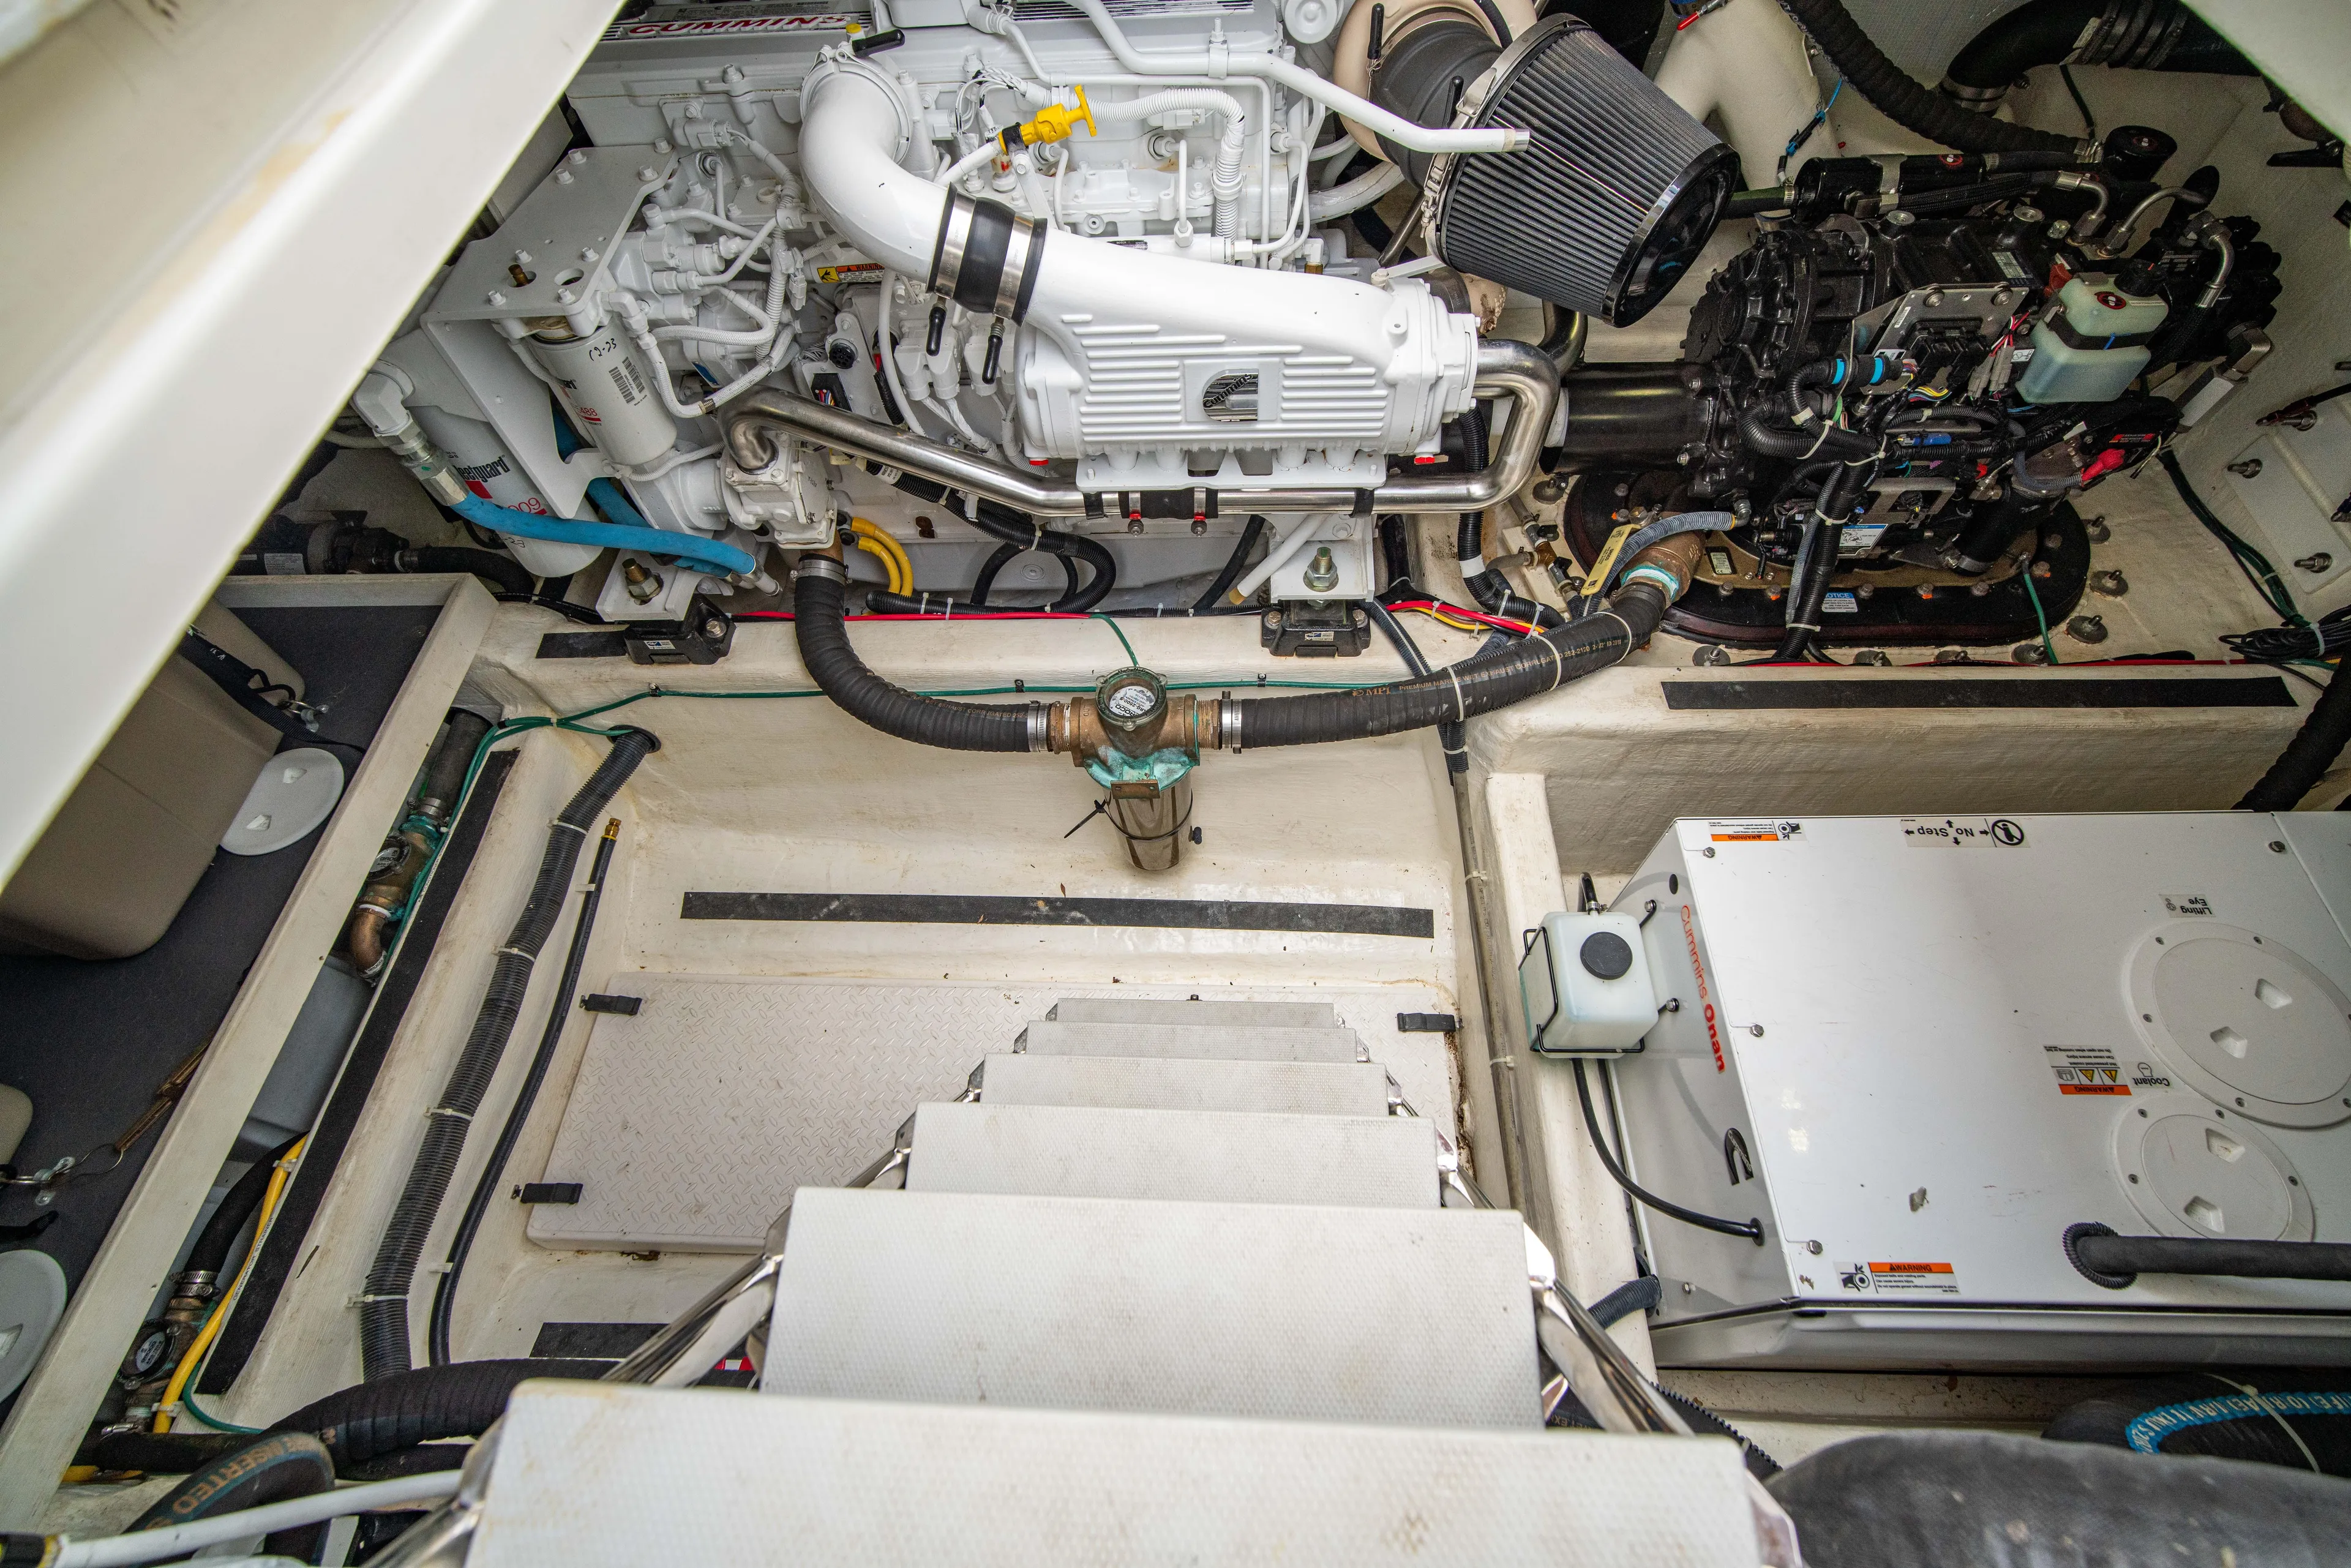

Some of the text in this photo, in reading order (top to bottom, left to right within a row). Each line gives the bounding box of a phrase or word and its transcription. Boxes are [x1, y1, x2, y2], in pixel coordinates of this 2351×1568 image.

[628, 16, 850, 35] CUMMINS
[1202, 373, 1253, 408] Cummins
[1366, 686, 1392, 696] MPI
[1399, 681, 1432, 691] PREMIUM
[1480, 666, 1515, 678] EXHAUST
[1515, 653, 1564, 670] CORRUGATD
[1564, 646, 1591, 658] 252-2120
[938, 703, 966, 712] EXHAUST
[967, 708, 1011, 718] CORRUGATED
[1917, 825, 1975, 837] No Step
[2180, 906, 2213, 915] Lifting
[2188, 898, 2208, 906] Eye
[1681, 904, 1725, 1073] Cummins Onan
[2133, 1078, 2170, 1086] Coolant
[233, 1217, 274, 1300] GENERATOR STRAINER
